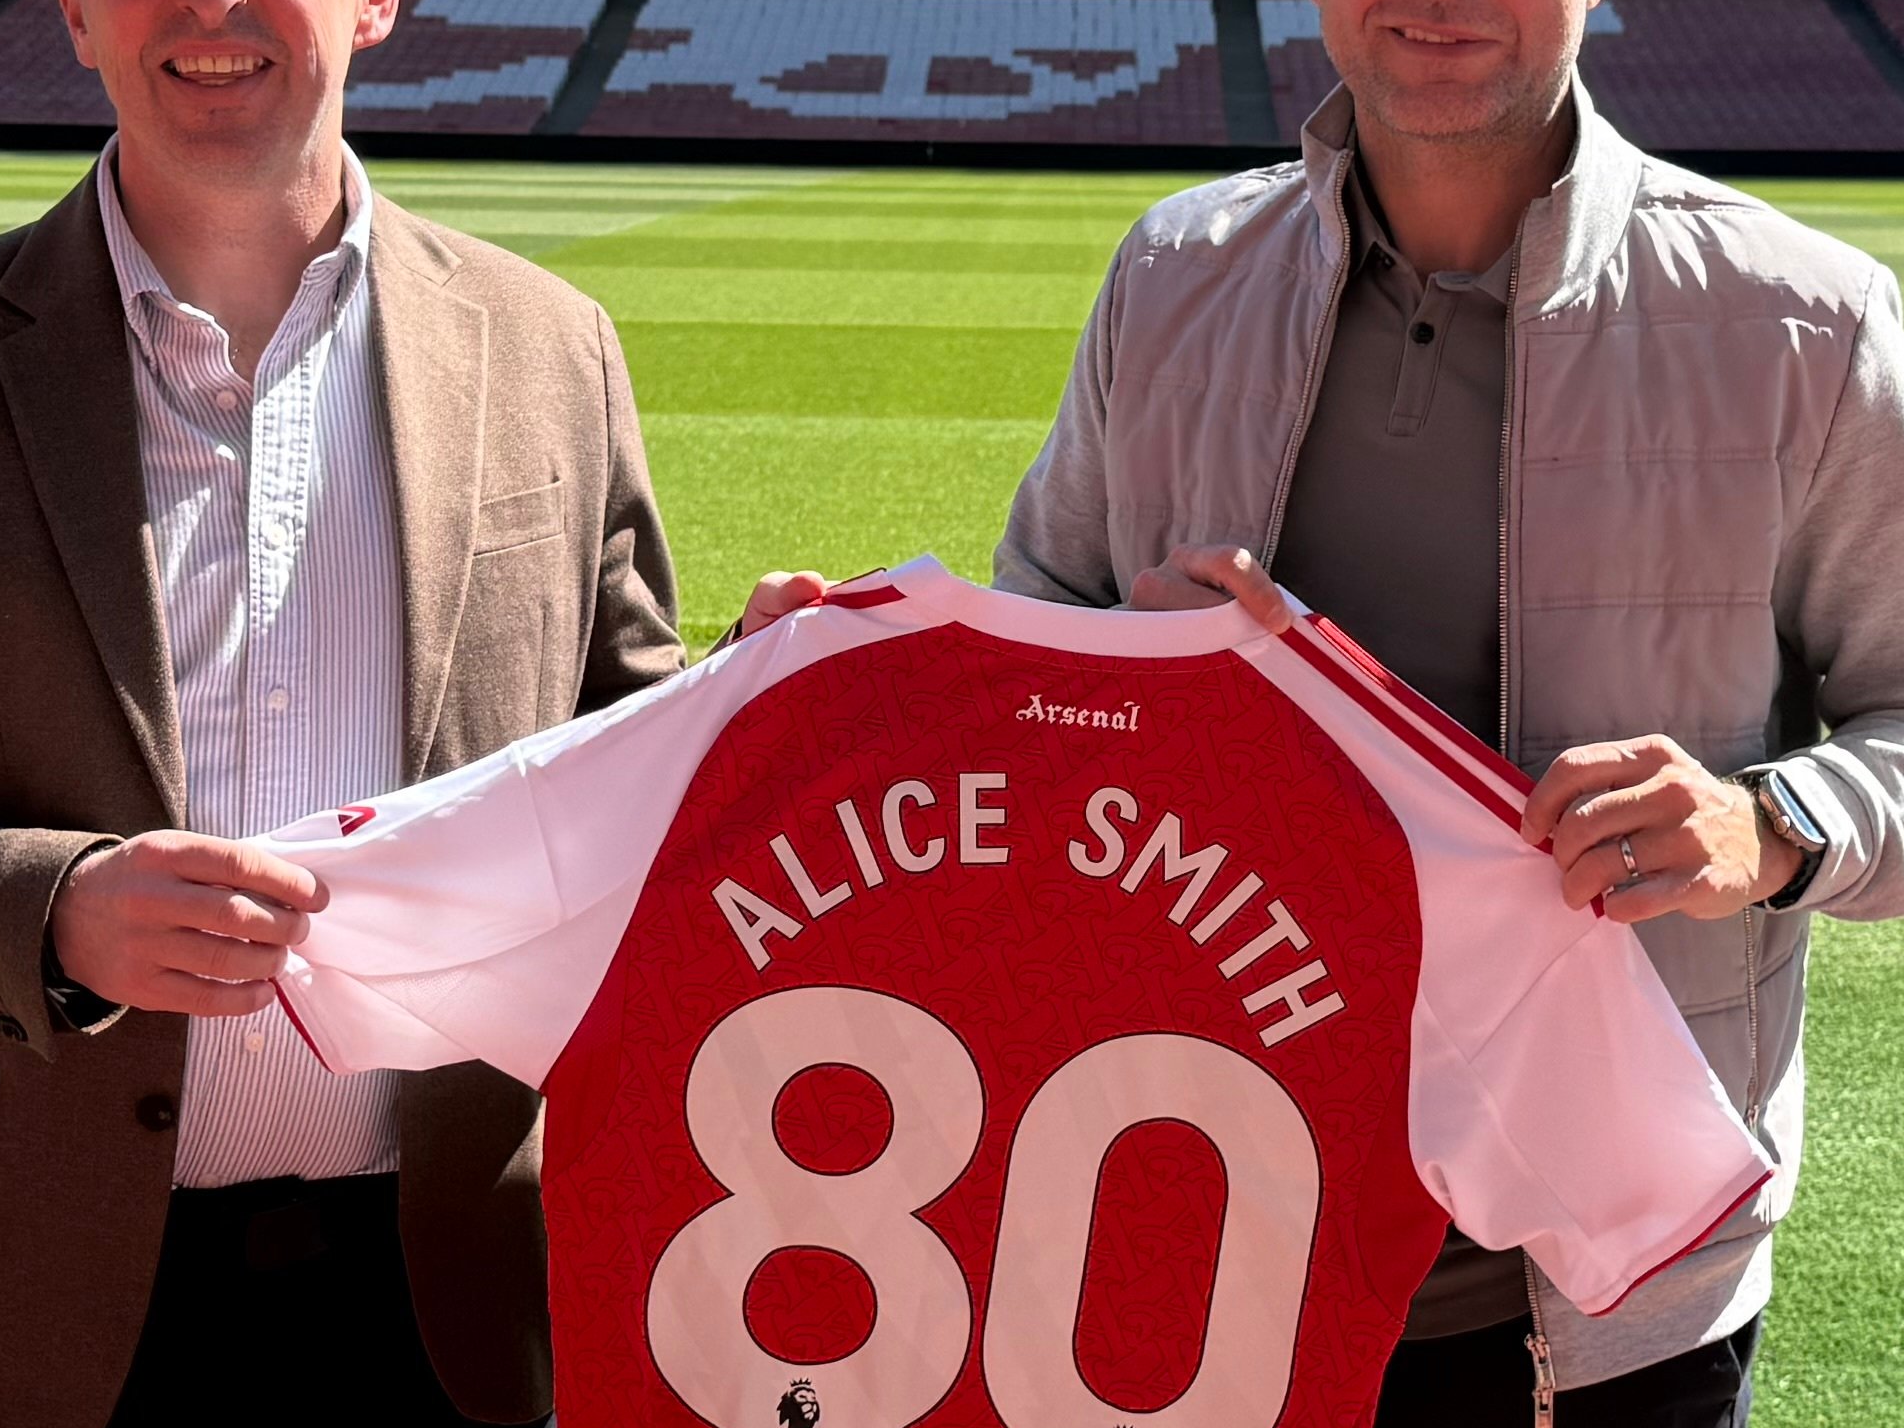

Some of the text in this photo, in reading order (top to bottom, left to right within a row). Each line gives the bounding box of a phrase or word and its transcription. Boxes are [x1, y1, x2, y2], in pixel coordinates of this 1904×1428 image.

[1016, 694, 1141, 733] Arsenal
[712, 772, 1346, 1048] ALICE SMITH
